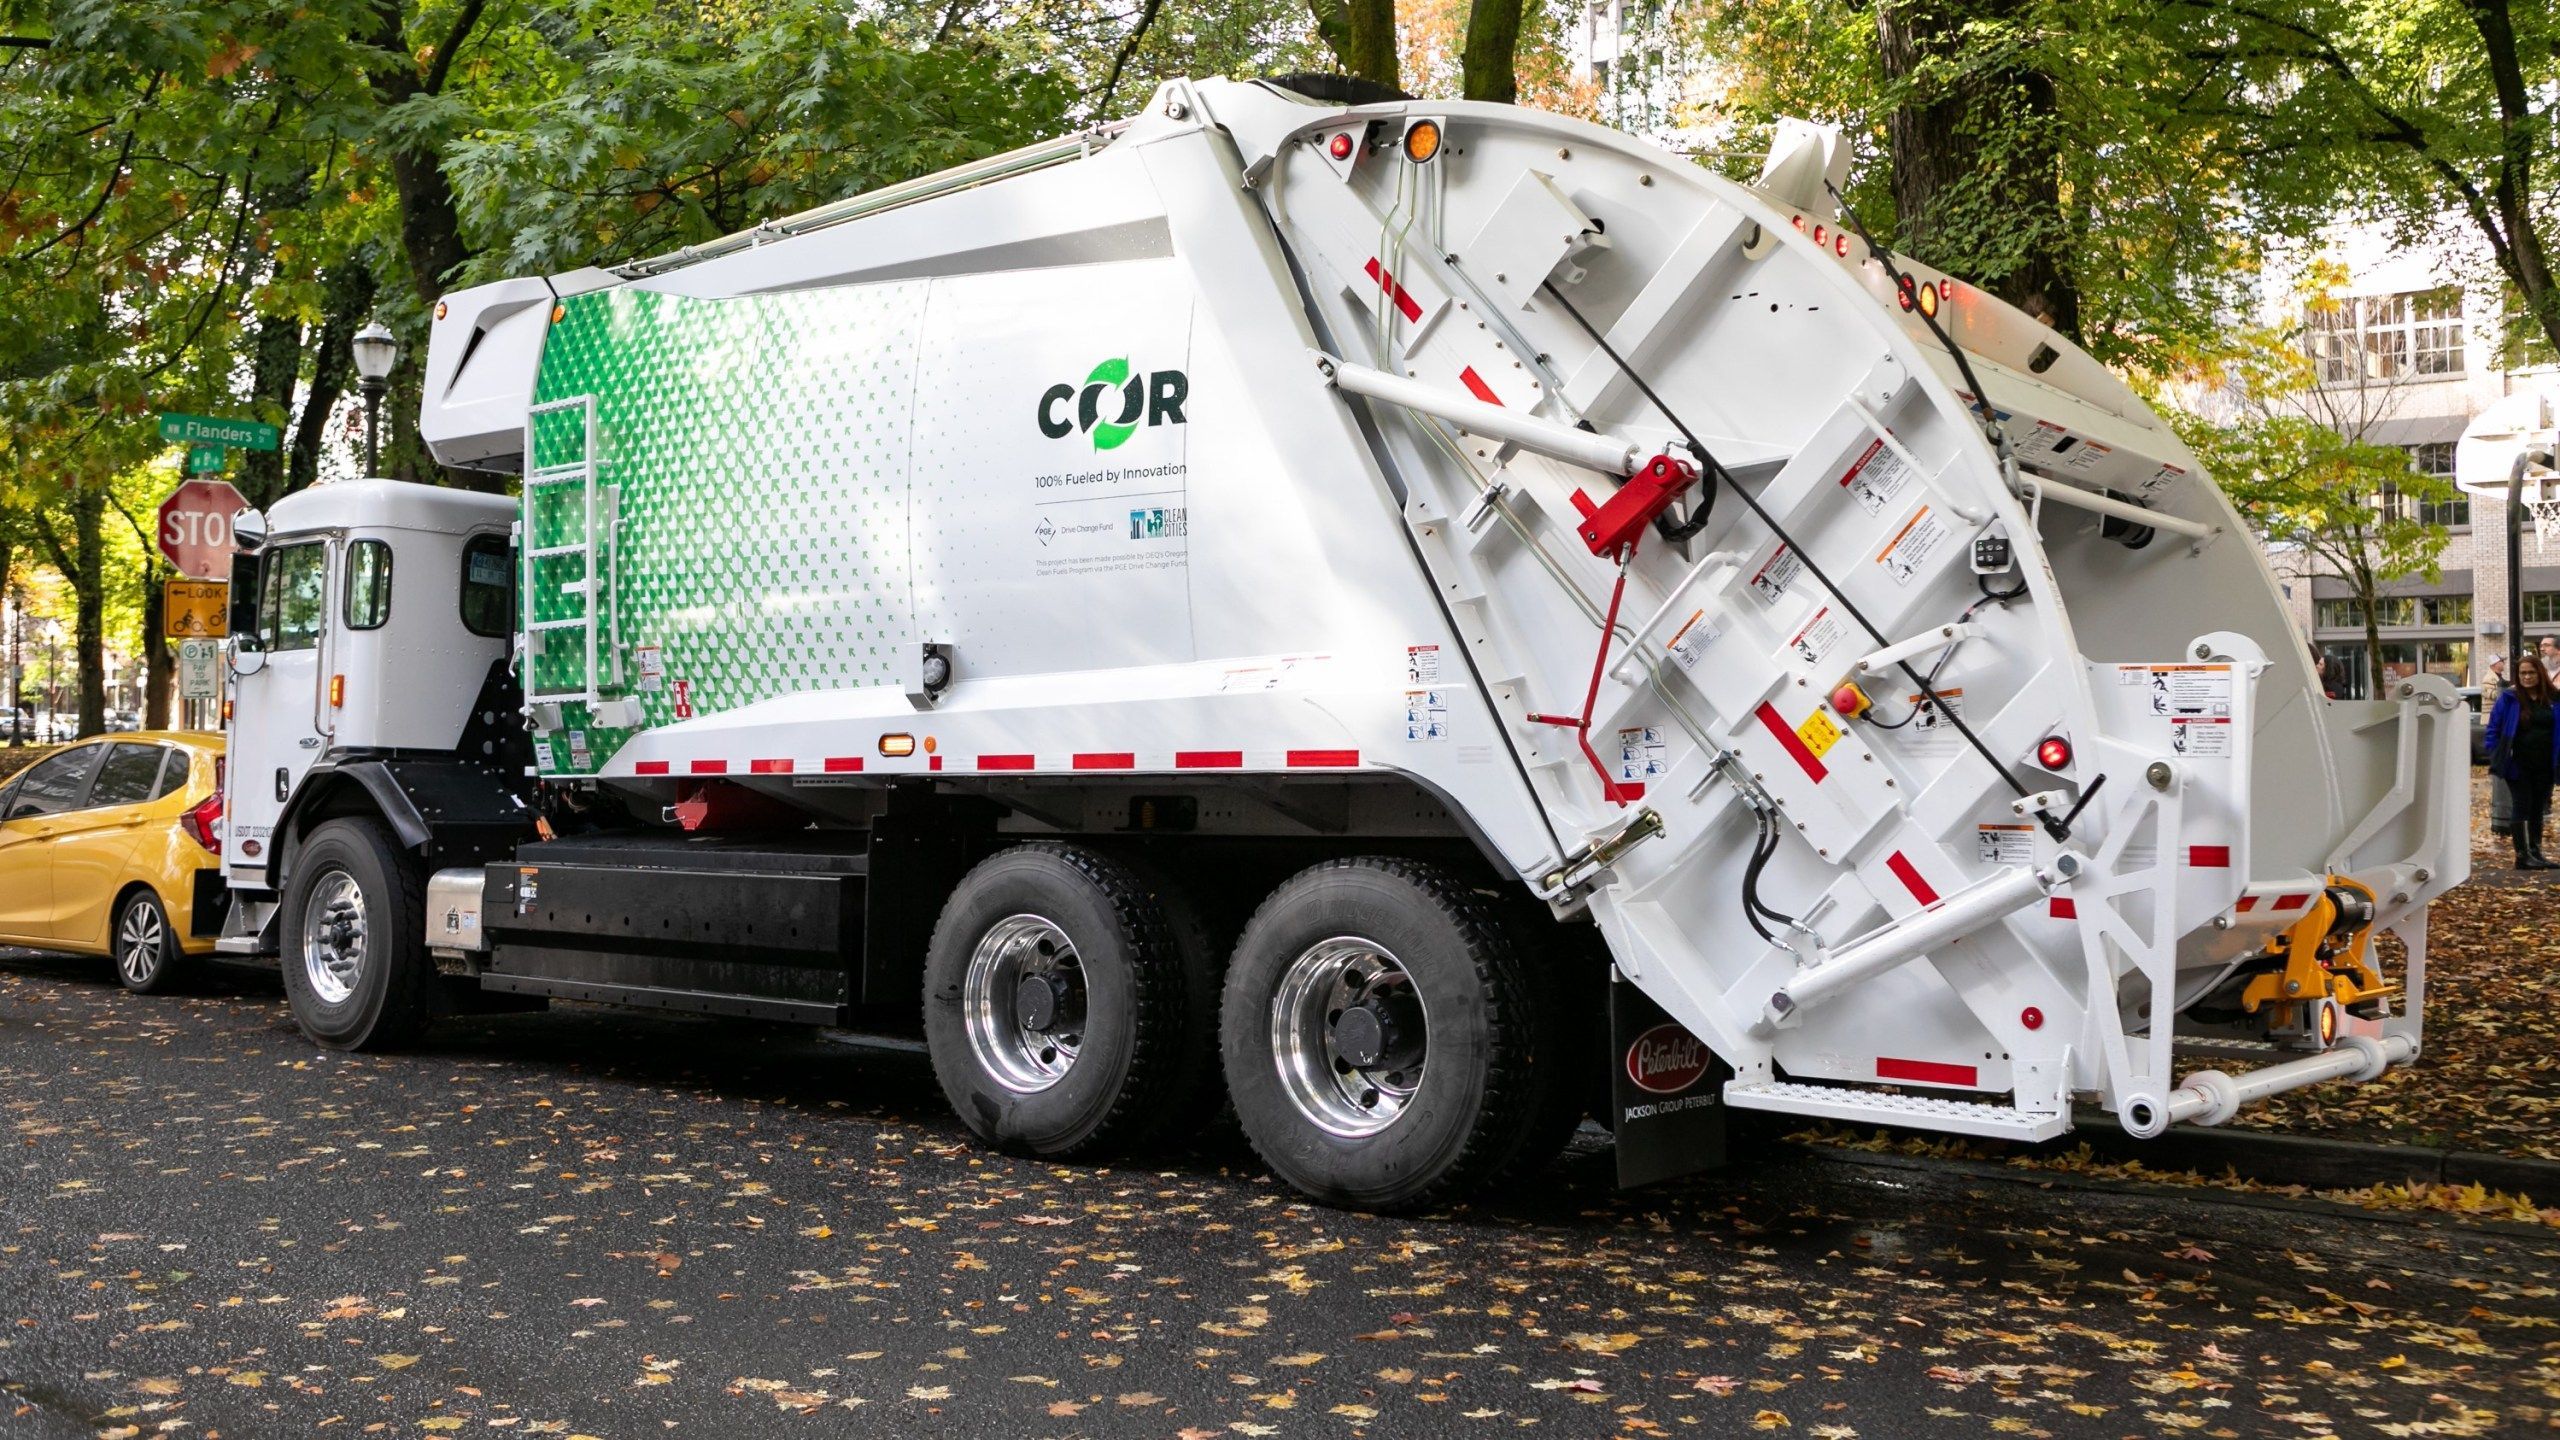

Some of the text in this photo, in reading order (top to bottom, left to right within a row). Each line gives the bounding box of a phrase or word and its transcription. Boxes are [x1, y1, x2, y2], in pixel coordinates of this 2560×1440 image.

[1038, 356, 1188, 452] COR
[186, 421, 253, 443] Flanders
[1035, 463, 1187, 488] 100% Fueled by Innovation
[1163, 507, 1188, 523] CLEAN
[1039, 528, 1052, 536] PGE
[1061, 523, 1114, 535] Drive Change Fund
[1164, 522, 1188, 538] CITIES
[187, 587, 223, 599] LOOK
[190, 678, 210, 686] PARK
[1638, 1038, 1701, 1080] Peterbilt
[1625, 1093, 1716, 1123] JACKSON GROUP PETERBILT
